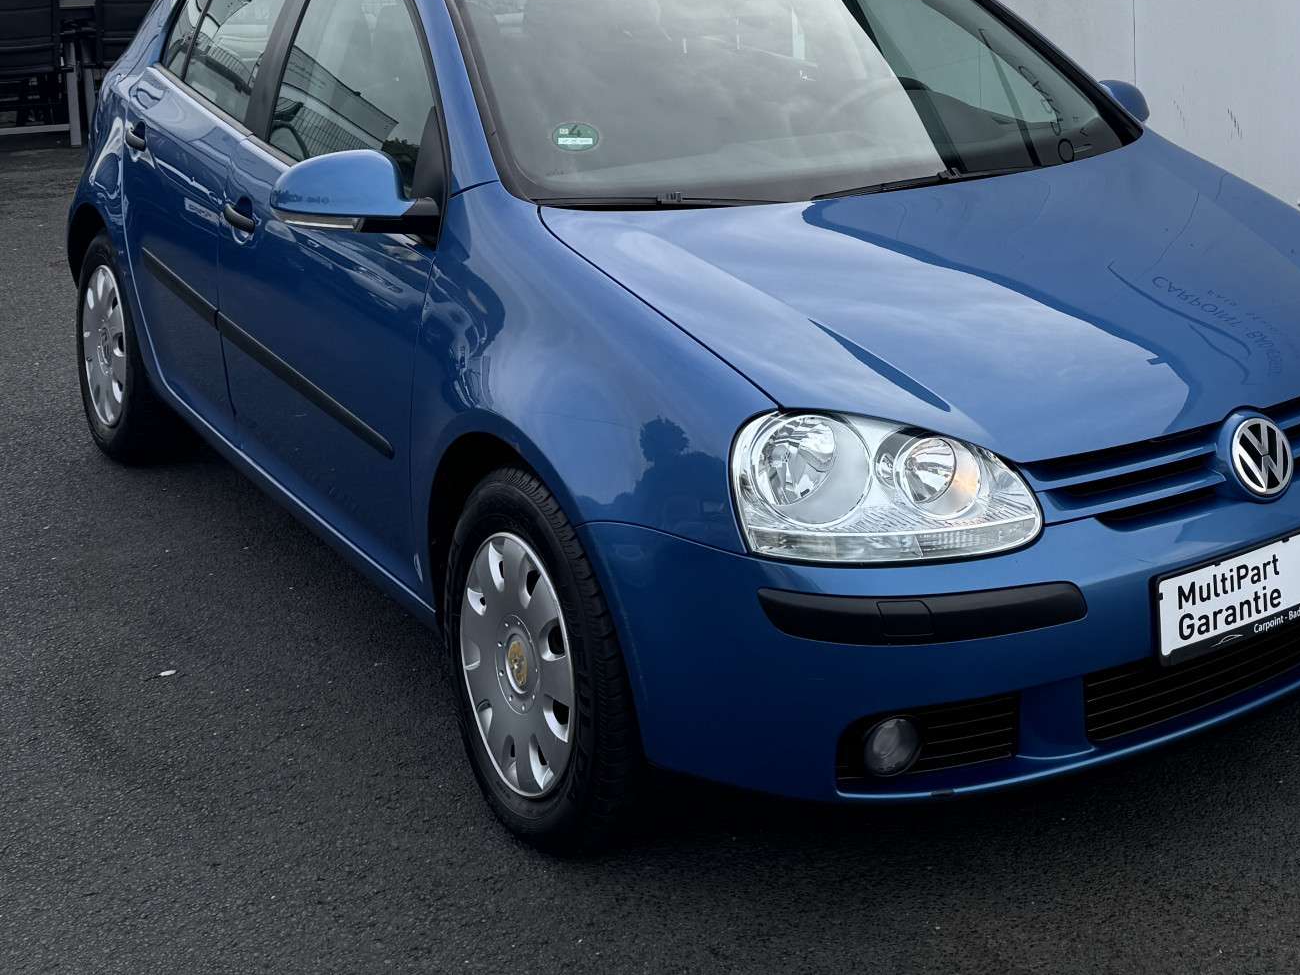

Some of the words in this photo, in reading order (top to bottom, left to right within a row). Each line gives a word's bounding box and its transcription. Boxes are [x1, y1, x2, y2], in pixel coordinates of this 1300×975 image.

[1177, 553, 1280, 610] MultiPart
[1178, 585, 1282, 641] Garantie
[1253, 615, 1284, 634] Carpoint
[1288, 606, 1300, 621] Bad
